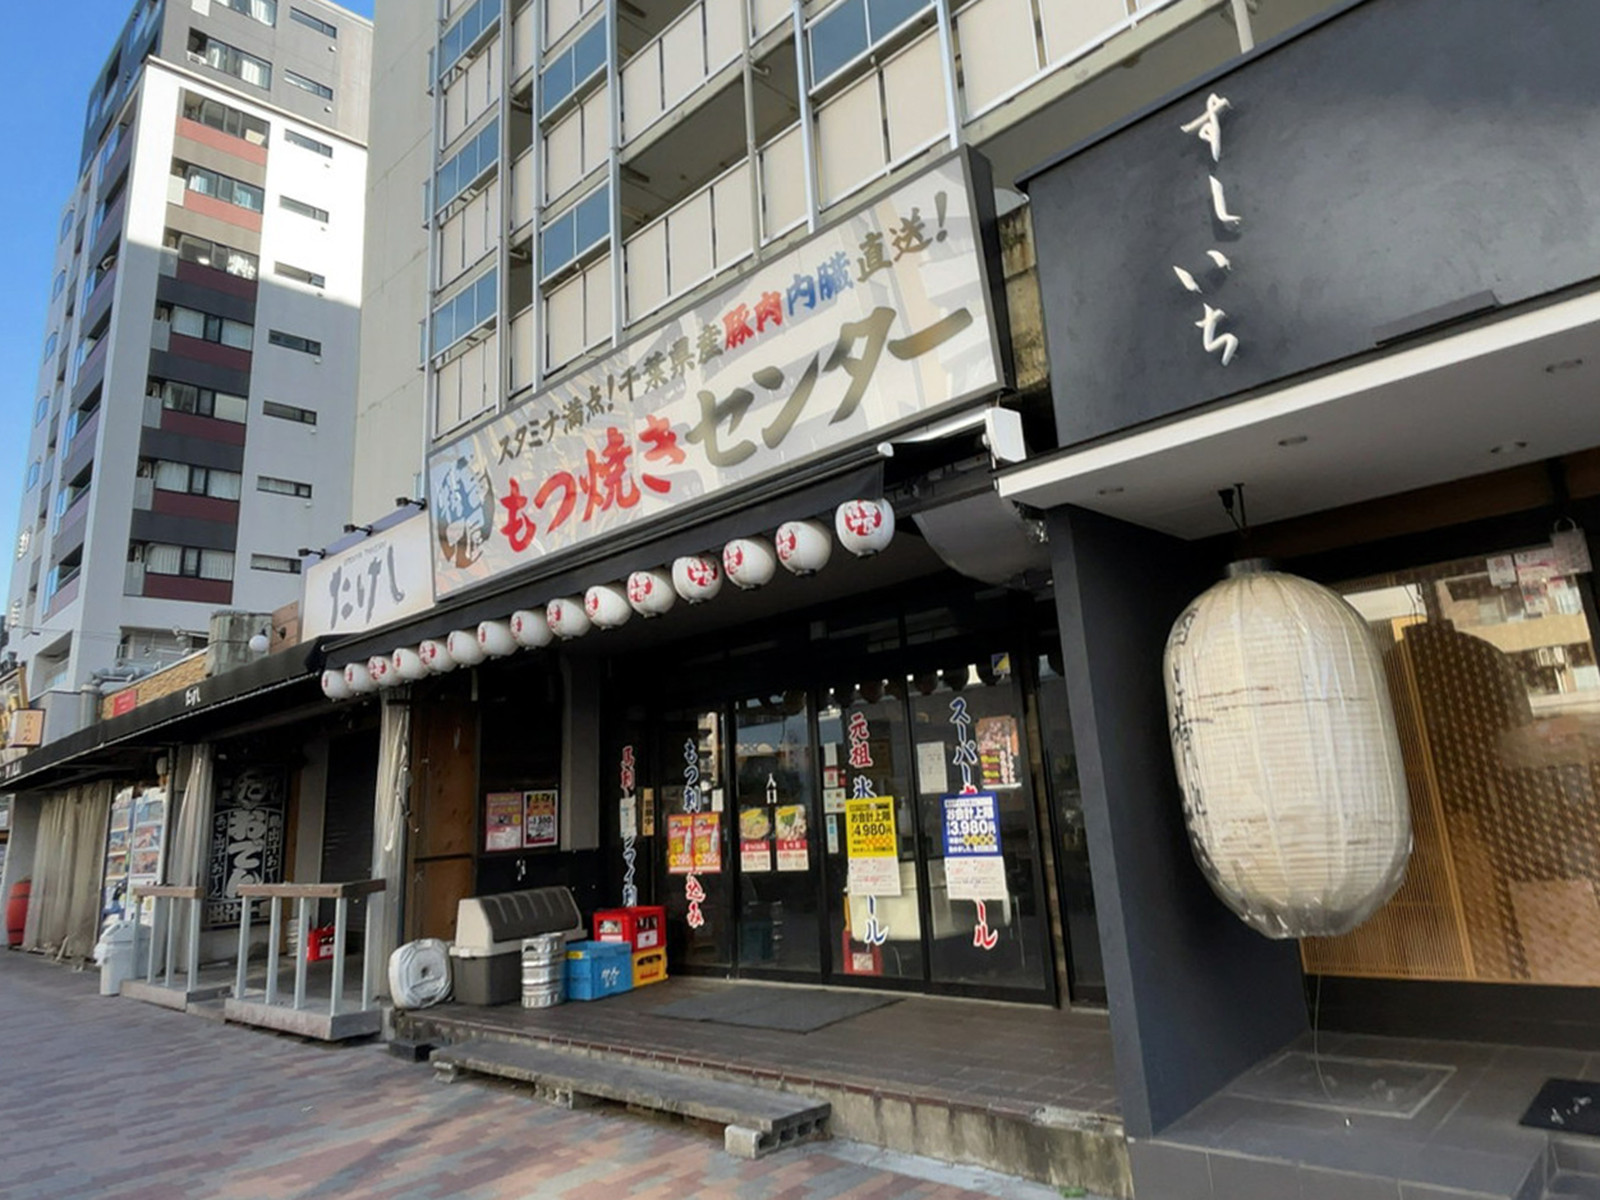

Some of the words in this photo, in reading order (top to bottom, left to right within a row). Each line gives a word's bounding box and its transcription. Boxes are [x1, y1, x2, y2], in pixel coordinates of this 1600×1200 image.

[1172, 92, 1242, 367] すしいち
[329, 544, 405, 630] たけし
[849, 712, 873, 768] 元祖
[685, 872, 706, 928] 込み
